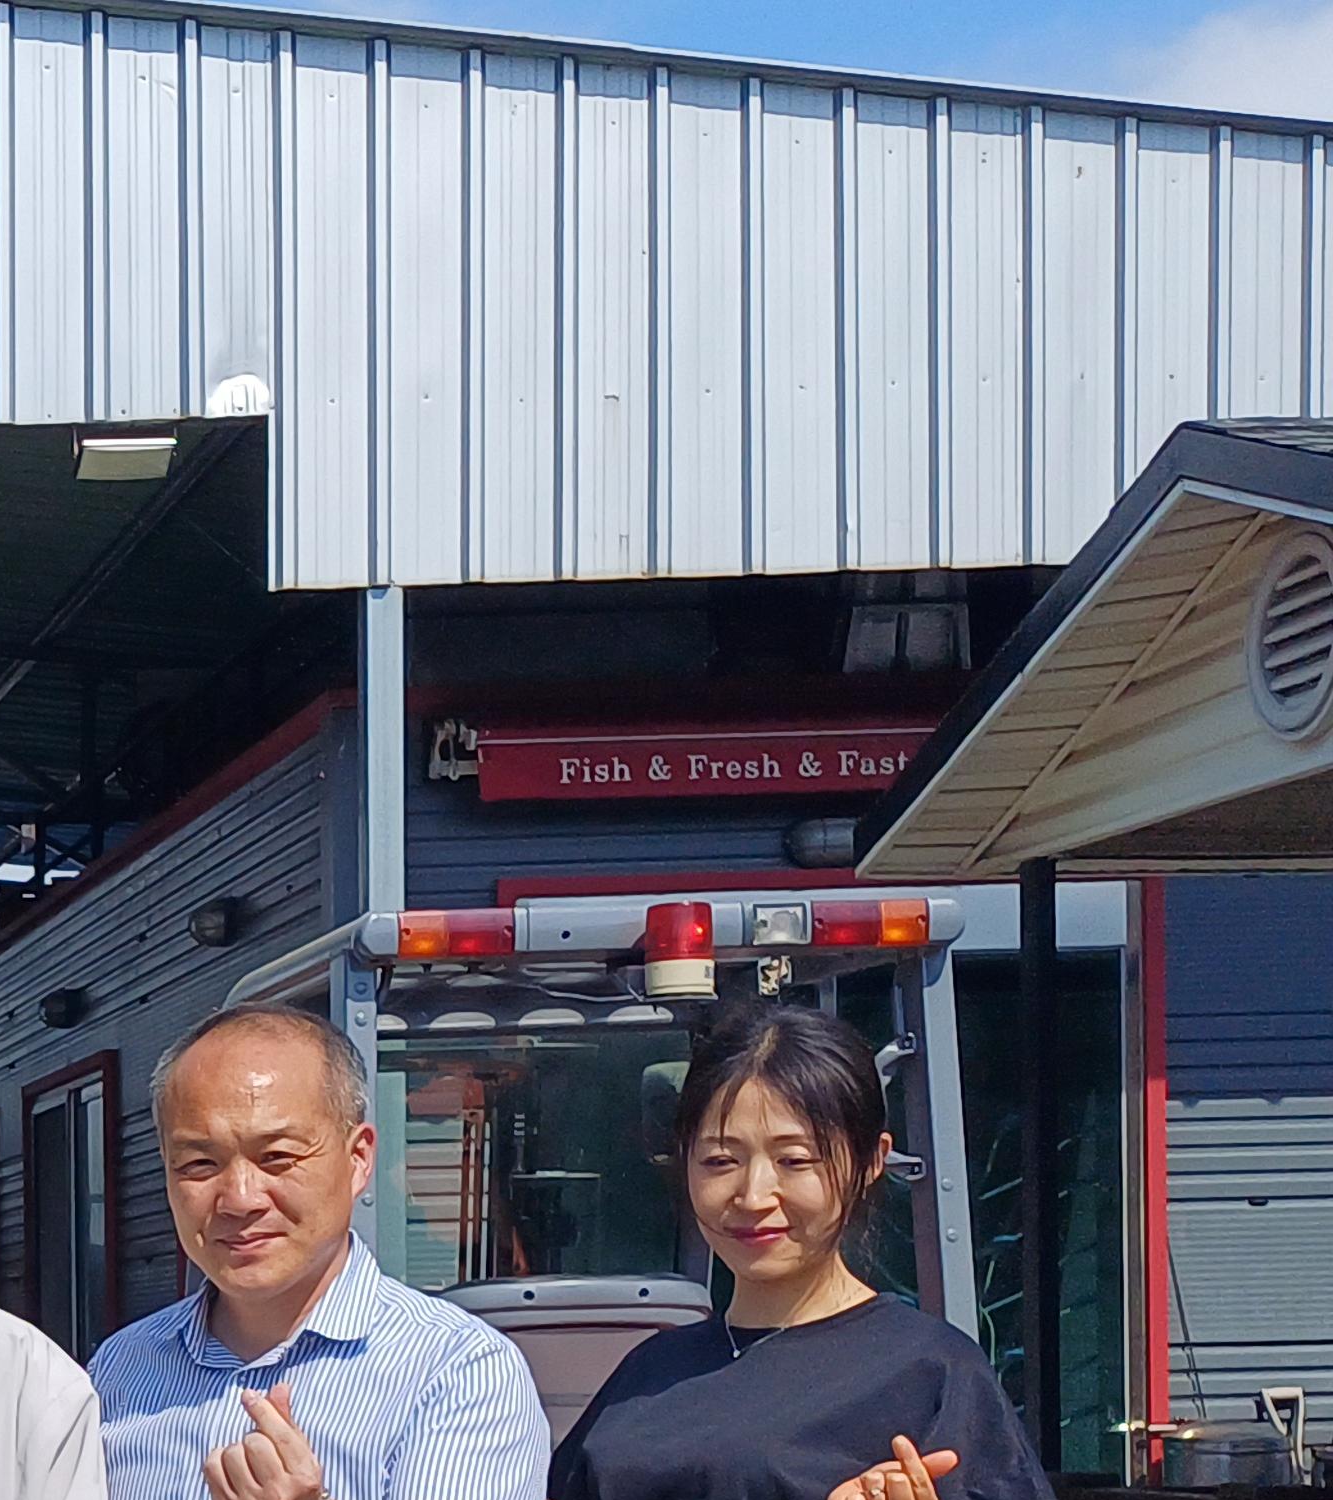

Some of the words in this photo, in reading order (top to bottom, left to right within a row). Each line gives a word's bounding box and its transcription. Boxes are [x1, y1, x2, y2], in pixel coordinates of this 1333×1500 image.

[559, 757, 632, 784] Fish
[647, 755, 672, 781] &
[687, 753, 782, 780] Fresh
[797, 752, 823, 777] &
[837, 750, 909, 776] Fast
